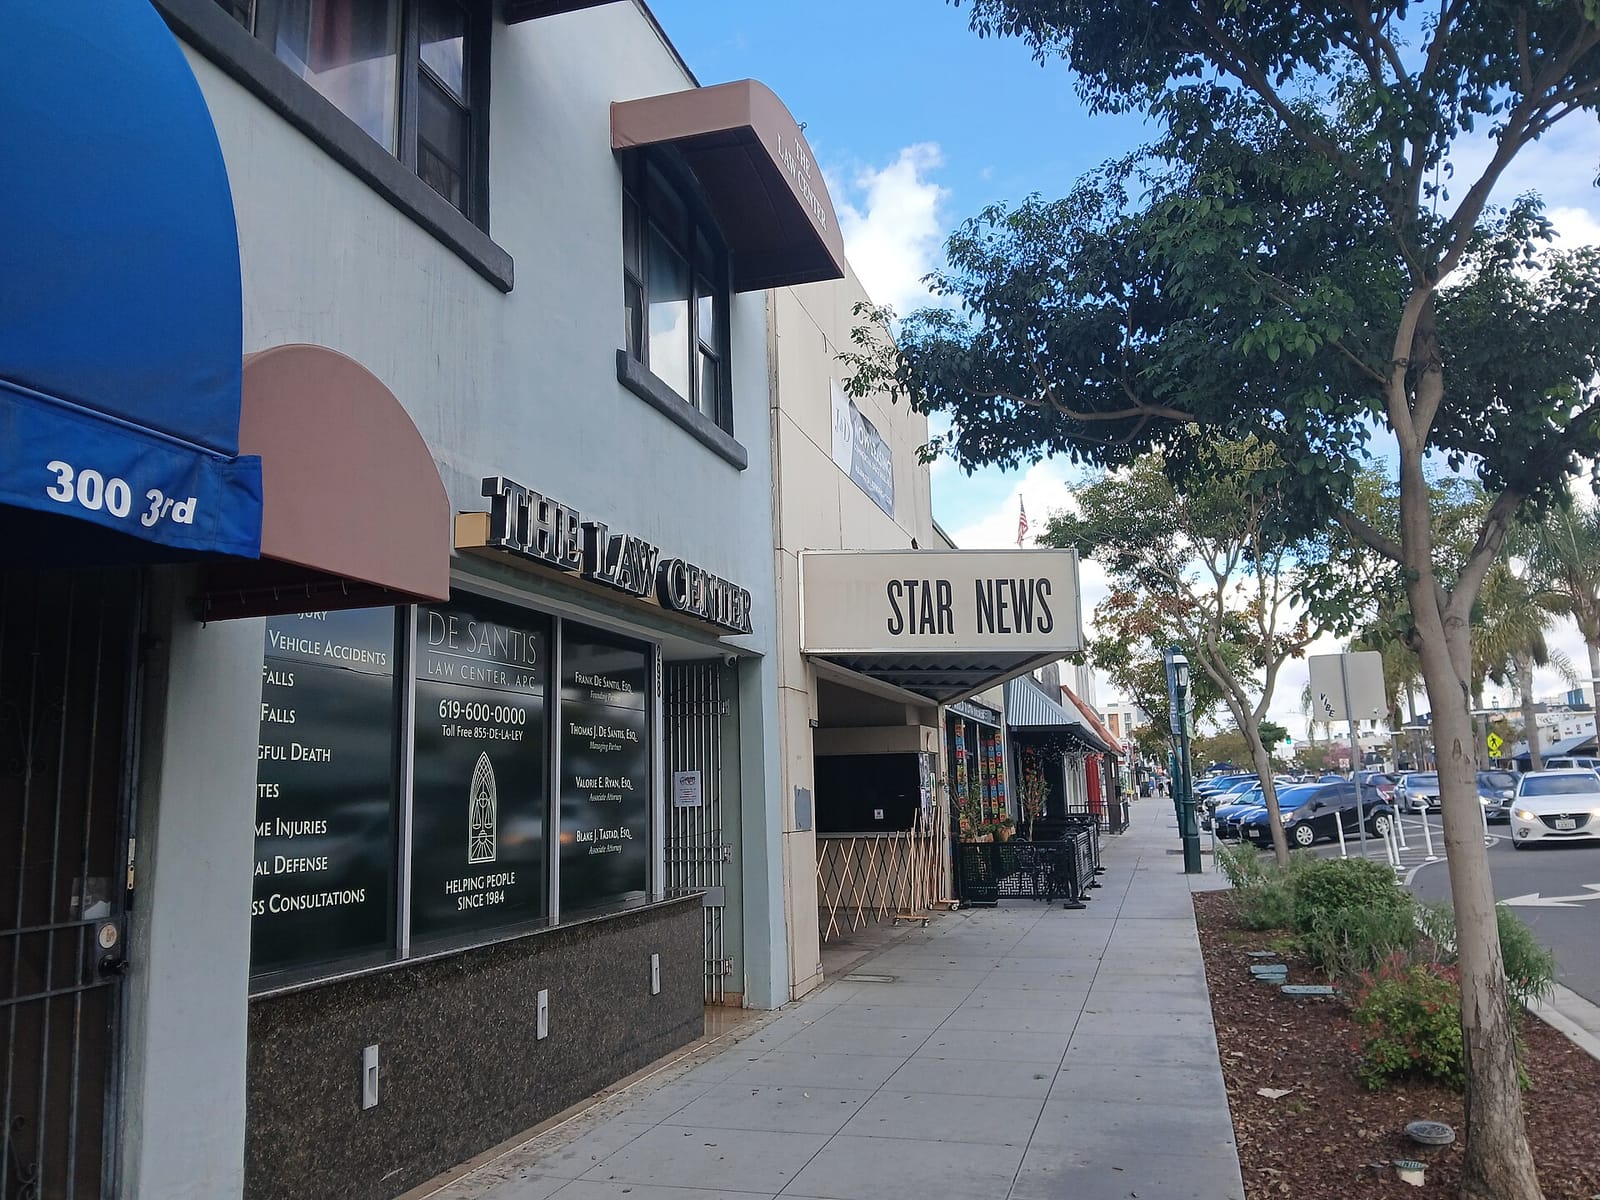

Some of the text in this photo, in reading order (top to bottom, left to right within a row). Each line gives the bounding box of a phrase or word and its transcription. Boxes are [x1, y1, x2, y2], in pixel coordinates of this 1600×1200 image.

[794, 137, 811, 179] THE
[777, 132, 827, 231] LAW CENTER
[46, 460, 197, 527] 300 3rd
[481, 476, 753, 634] THE LAW CENTER
[887, 577, 1054, 636] STAR NEWS
[268, 629, 386, 666] VEHICLE ACCIDENTS
[428, 611, 537, 665] DE SANTIS
[262, 665, 294, 687] FALLS
[428, 658, 455, 676] LAW
[515, 674, 536, 690] APC
[575, 671, 594, 686] FRANK
[261, 703, 296, 724] FALLS
[439, 699, 526, 726] 619-600-0000
[1319, 692, 1336, 718] VIBE
[441, 724, 524, 741] Toll Free 855-DE-LA-LEY
[569, 722, 593, 737] THOMAS
[598, 725, 607, 738] DE
[290, 742, 331, 762] DEATH
[575, 776, 598, 789] VALORIE
[275, 817, 328, 839] INJURIES
[576, 830, 593, 842] BLAKE
[274, 855, 328, 874] DEFENSE
[445, 871, 516, 895] HELPING PEOPLE
[251, 888, 366, 916] SS CONSULTATIONS
[457, 890, 505, 911] SINCE 1984
